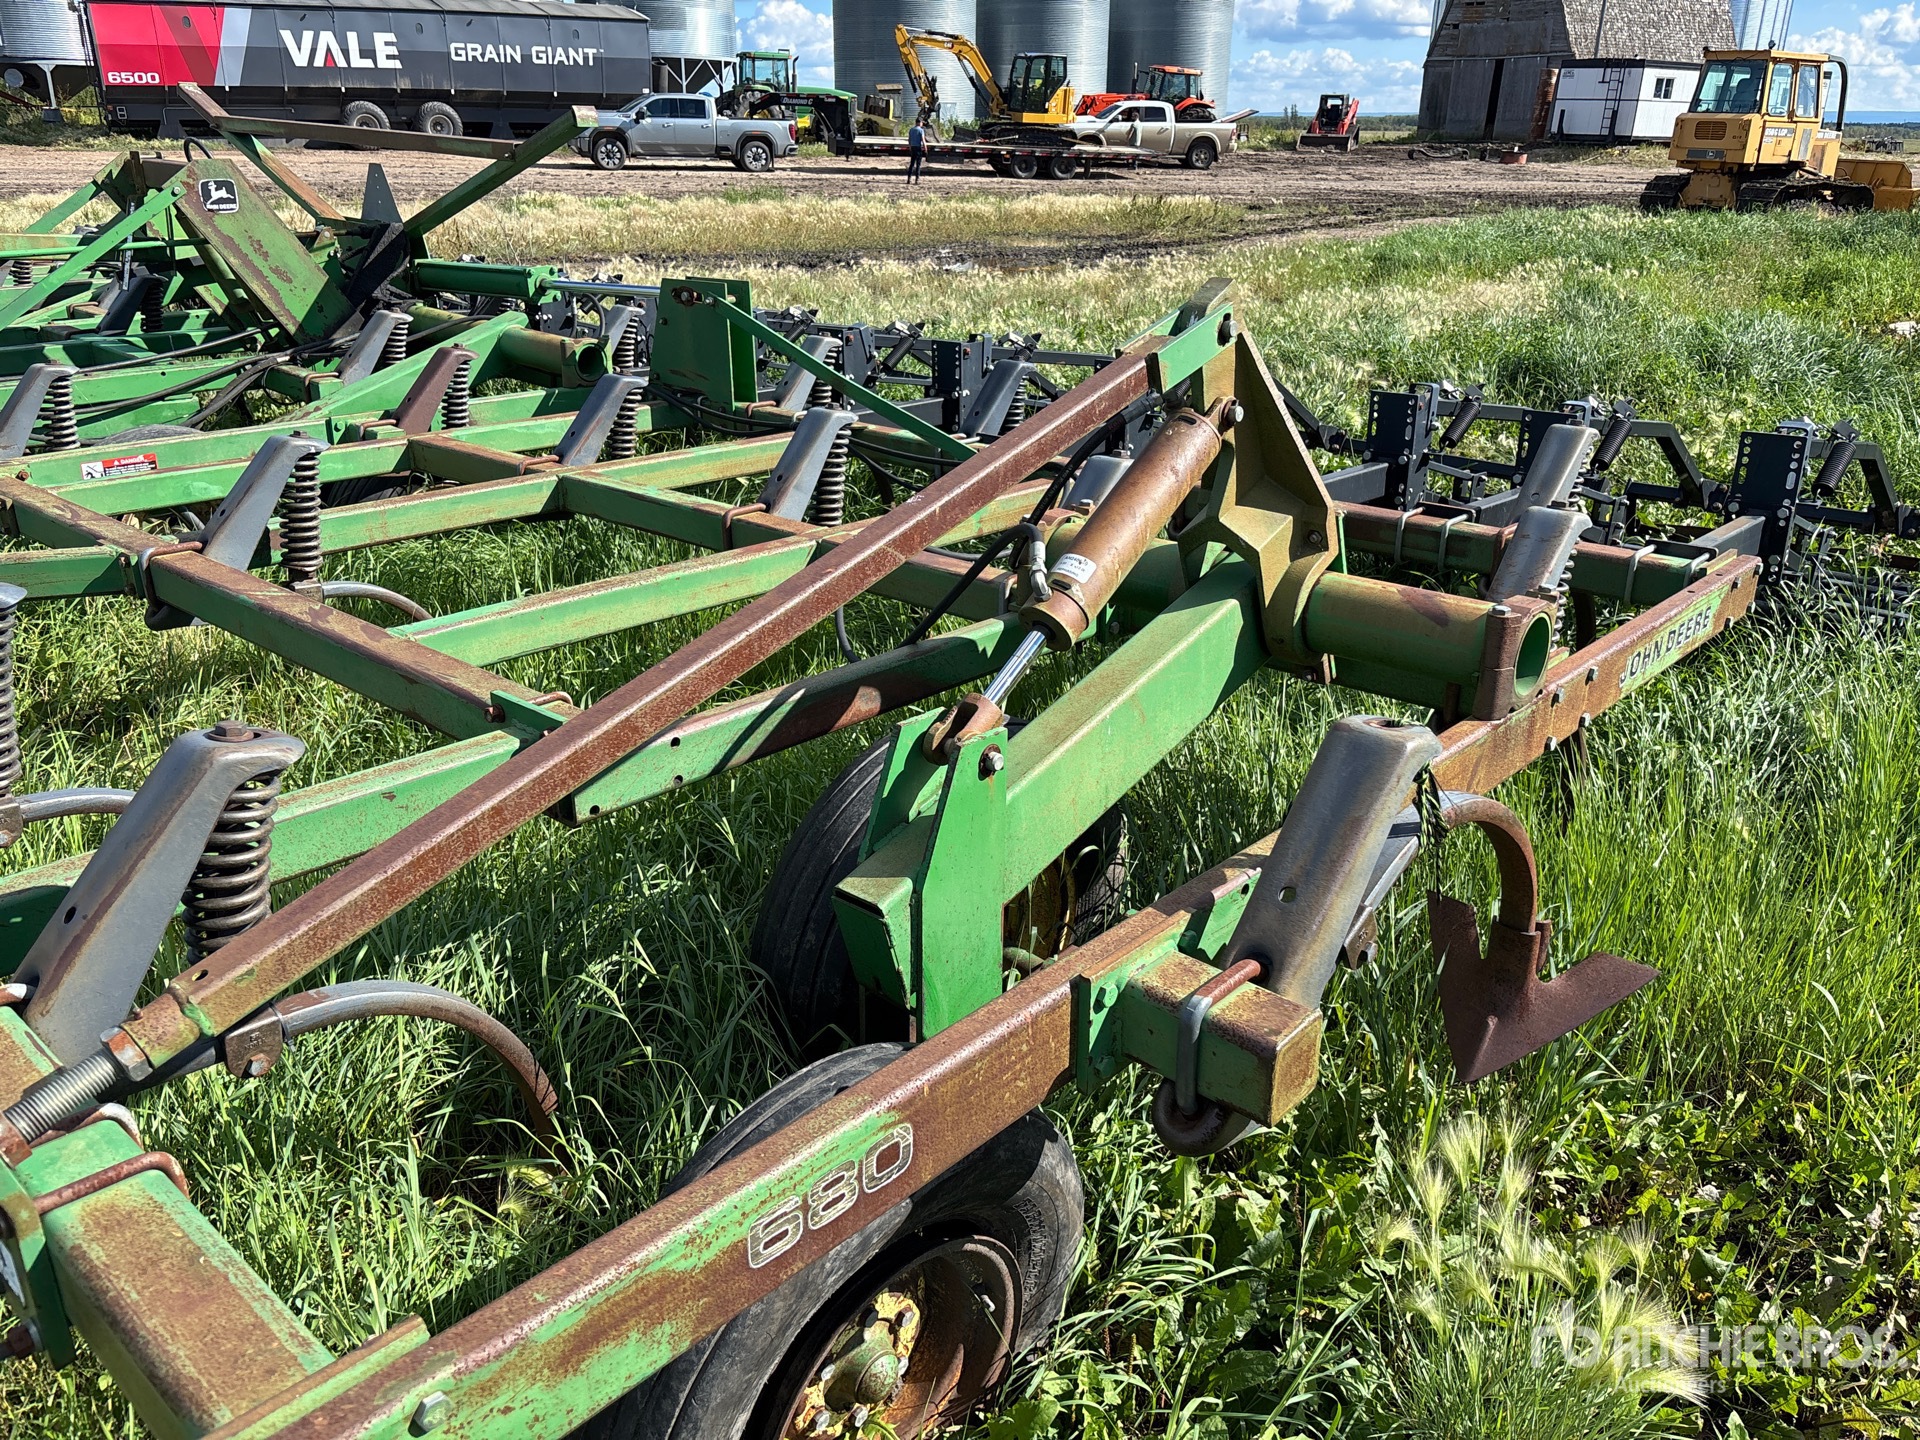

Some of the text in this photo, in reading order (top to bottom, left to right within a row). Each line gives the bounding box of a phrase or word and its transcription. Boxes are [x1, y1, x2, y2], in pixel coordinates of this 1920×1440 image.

[279, 29, 402, 69] VALE
[450, 42, 598, 66] GRAIN GIANT
[107, 72, 160, 84] 6500
[1619, 606, 1713, 687] JOHN DEERE
[748, 1122, 914, 1270] 680
